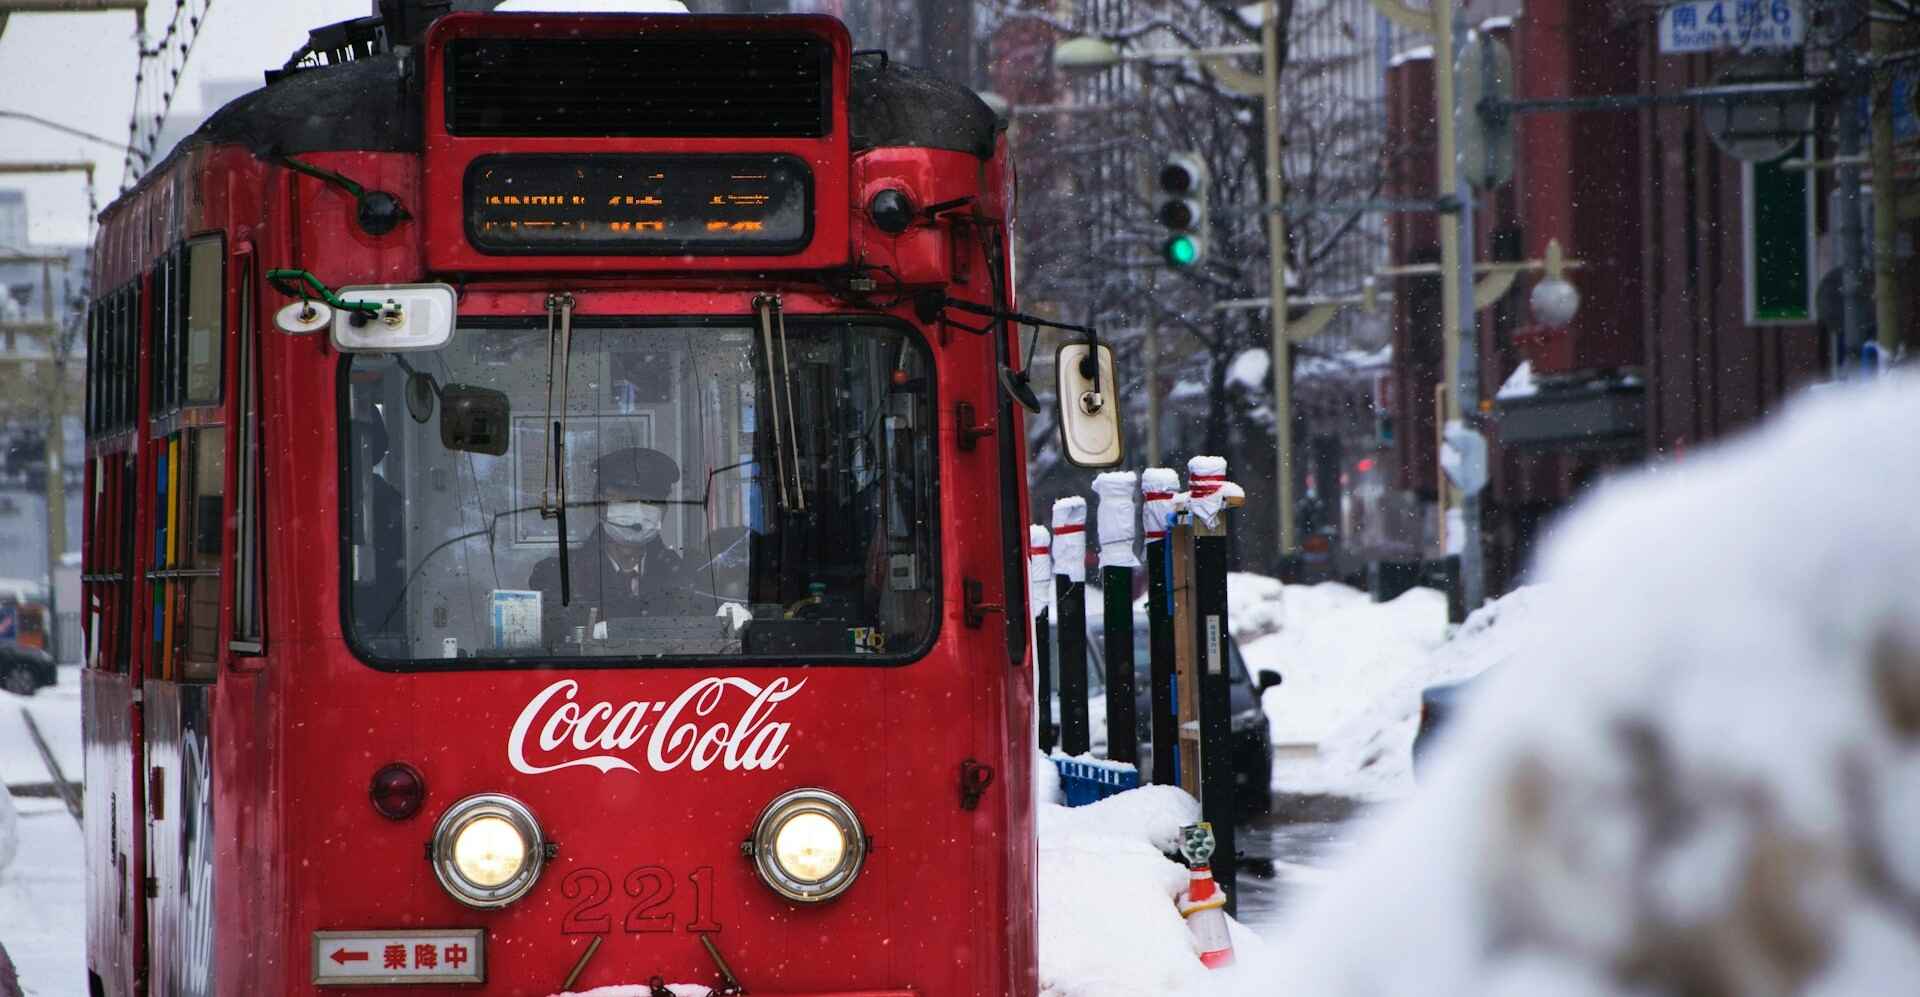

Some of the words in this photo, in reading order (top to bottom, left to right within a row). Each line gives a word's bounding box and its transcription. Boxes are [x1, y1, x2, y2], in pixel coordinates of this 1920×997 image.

[508, 676, 808, 774] Coca-Cola
[560, 865, 722, 935] 221
[383, 943, 467, 970] 乗降中
